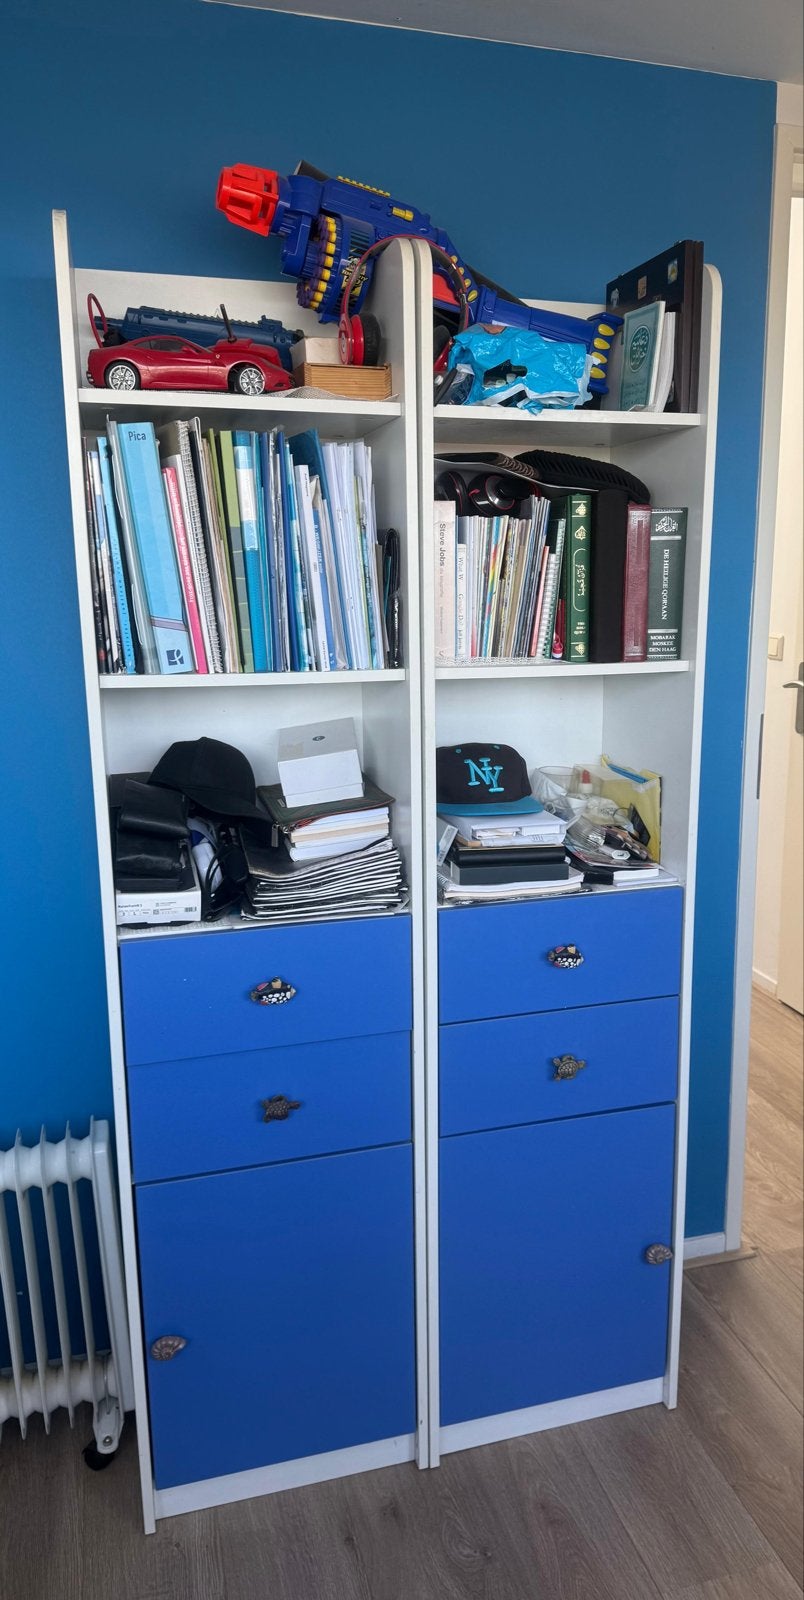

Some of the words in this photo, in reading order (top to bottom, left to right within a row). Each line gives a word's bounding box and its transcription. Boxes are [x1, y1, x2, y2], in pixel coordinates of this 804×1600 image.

[128, 430, 147, 442] Pica
[663, 549, 670, 560] DE
[662, 560, 670, 588] HEILIGE
[463, 757, 505, 793] NY
